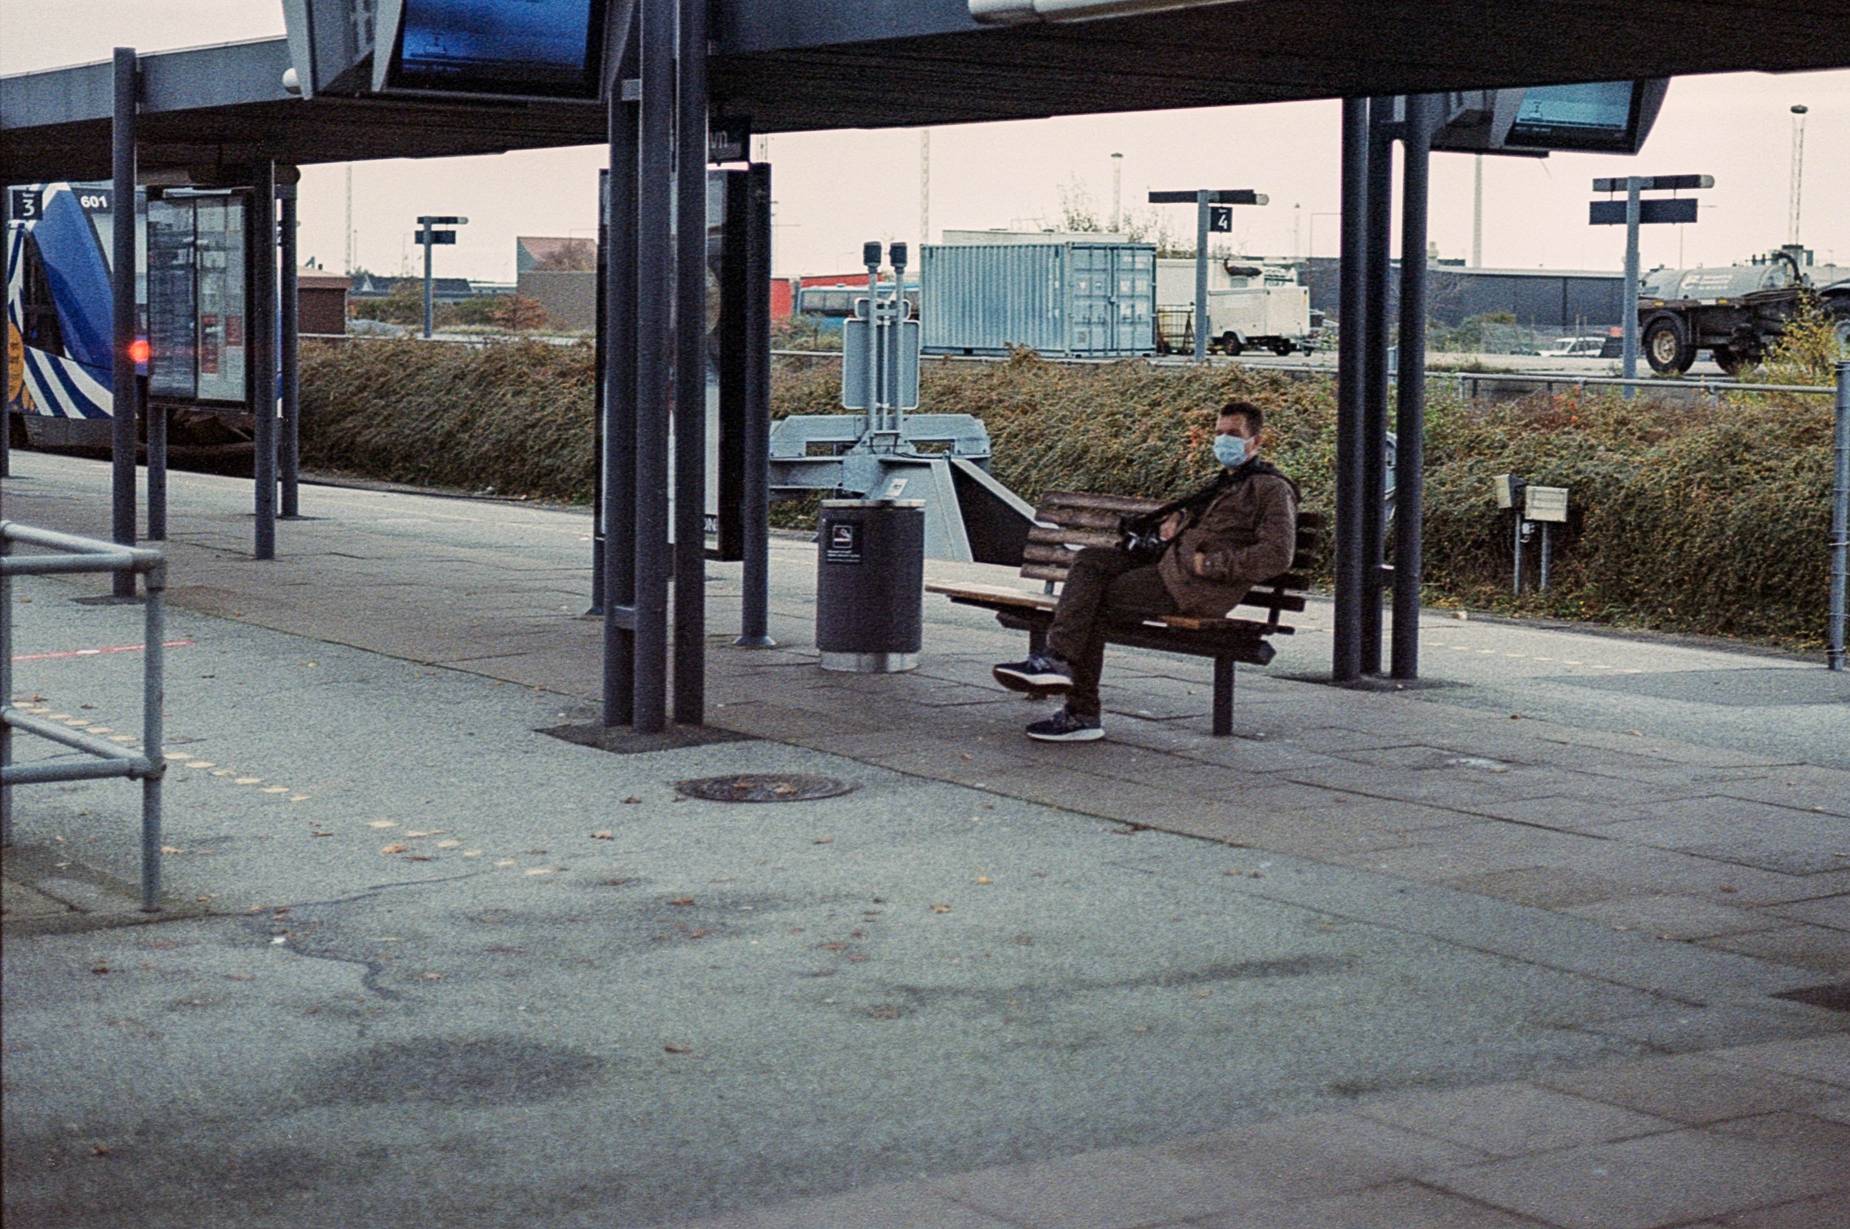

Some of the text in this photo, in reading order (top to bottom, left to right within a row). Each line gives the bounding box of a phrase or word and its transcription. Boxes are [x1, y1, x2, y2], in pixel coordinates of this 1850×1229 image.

[22, 199, 36, 217] 3
[80, 195, 108, 208] 601
[1218, 214, 1228, 230] 4
